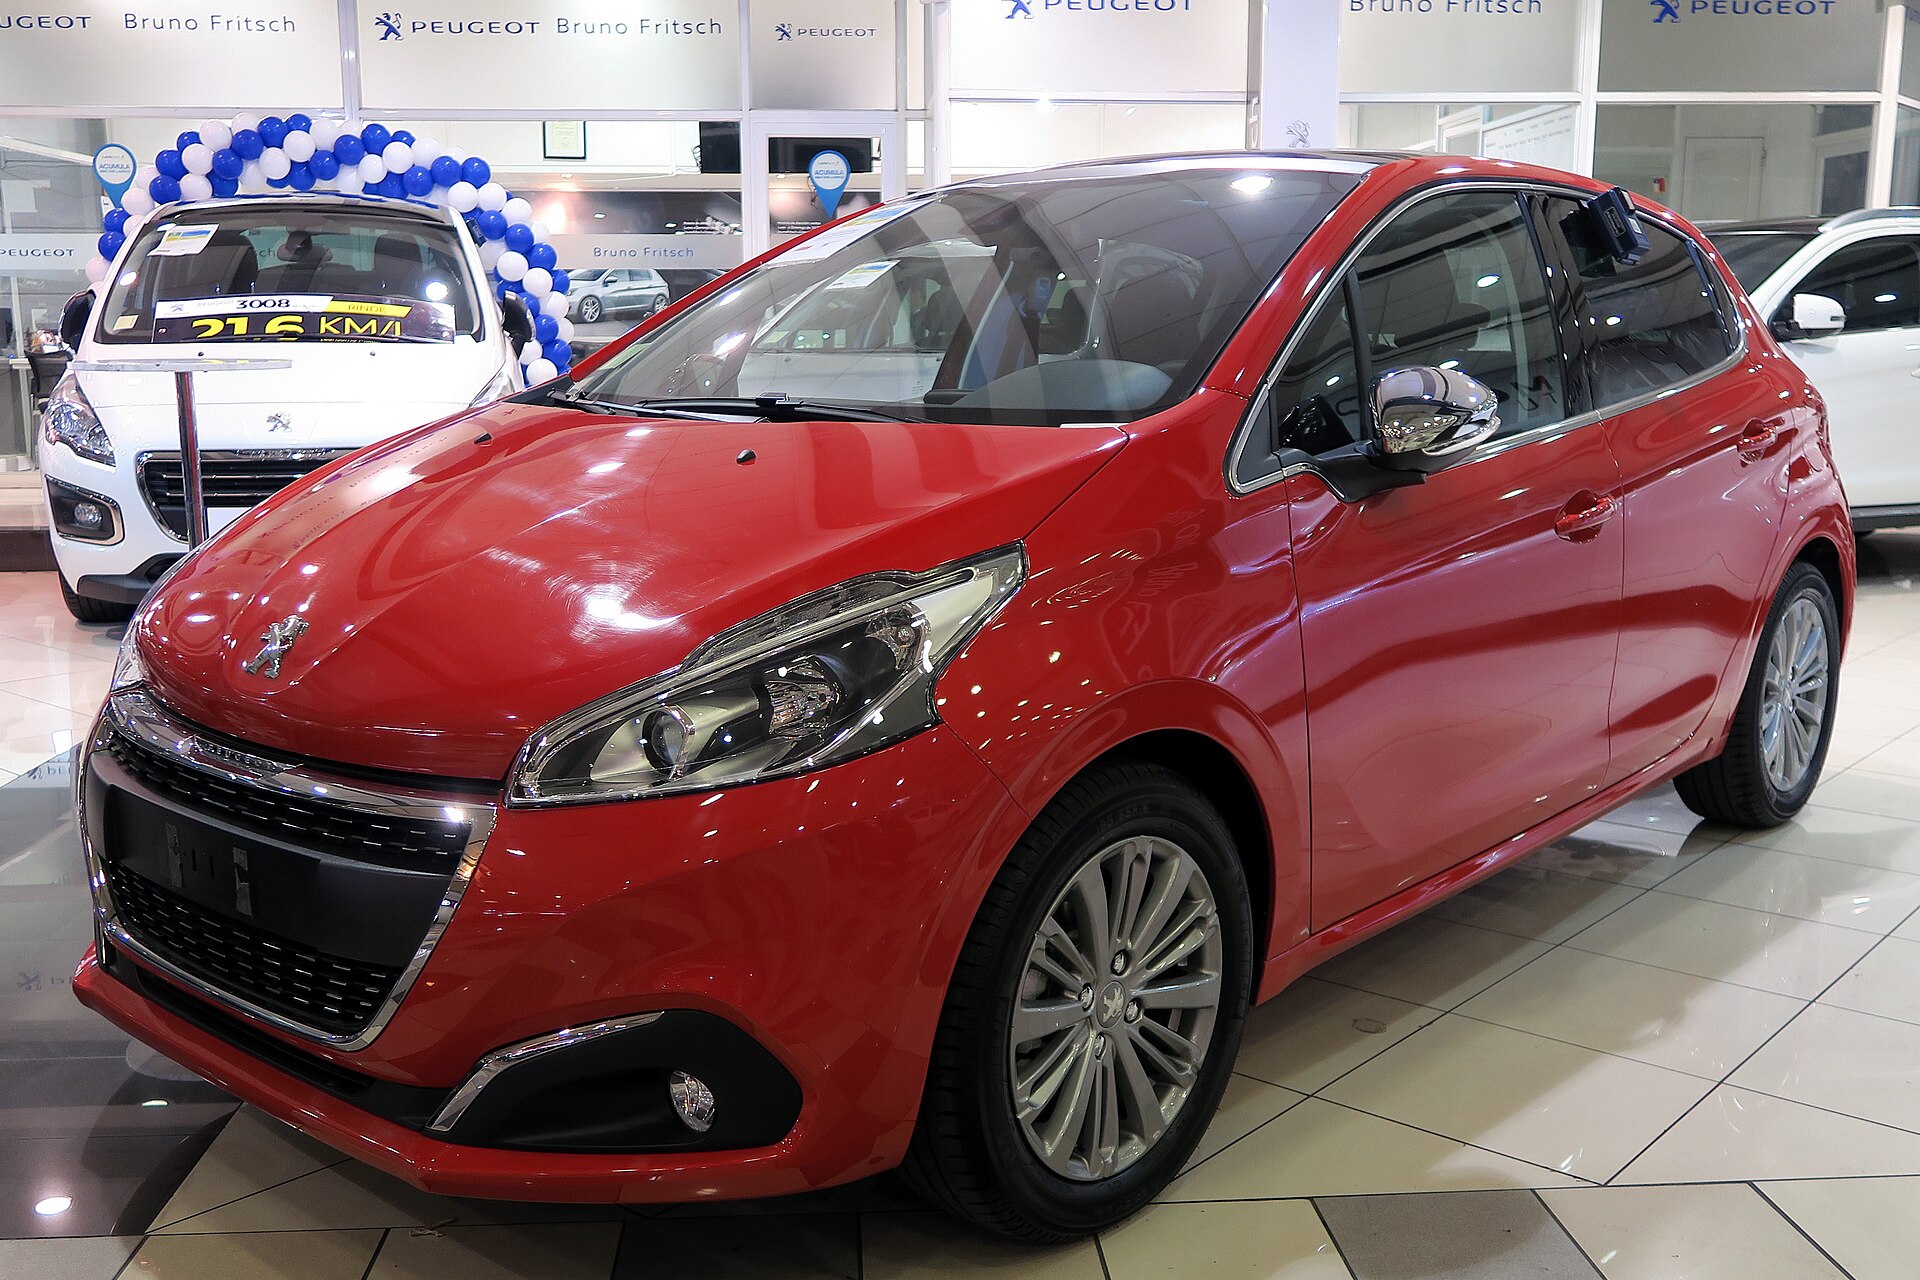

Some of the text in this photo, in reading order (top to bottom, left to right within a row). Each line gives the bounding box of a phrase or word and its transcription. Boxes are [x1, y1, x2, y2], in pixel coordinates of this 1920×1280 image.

[1350, 0, 1542, 14] Bruno Fritsch
[1690, 0, 1837, 15] PEUGEOT
[124, 13, 198, 31] Bruno
[210, 14, 296, 32] Fritsch
[411, 17, 722, 34] PEUGEOT Bruno Fritsch
[798, 28, 877, 37] PEUGEOT
[593, 246, 694, 257] Bruno Fritsch
[236, 299, 291, 310] 3008
[347, 303, 388, 314] RINDE
